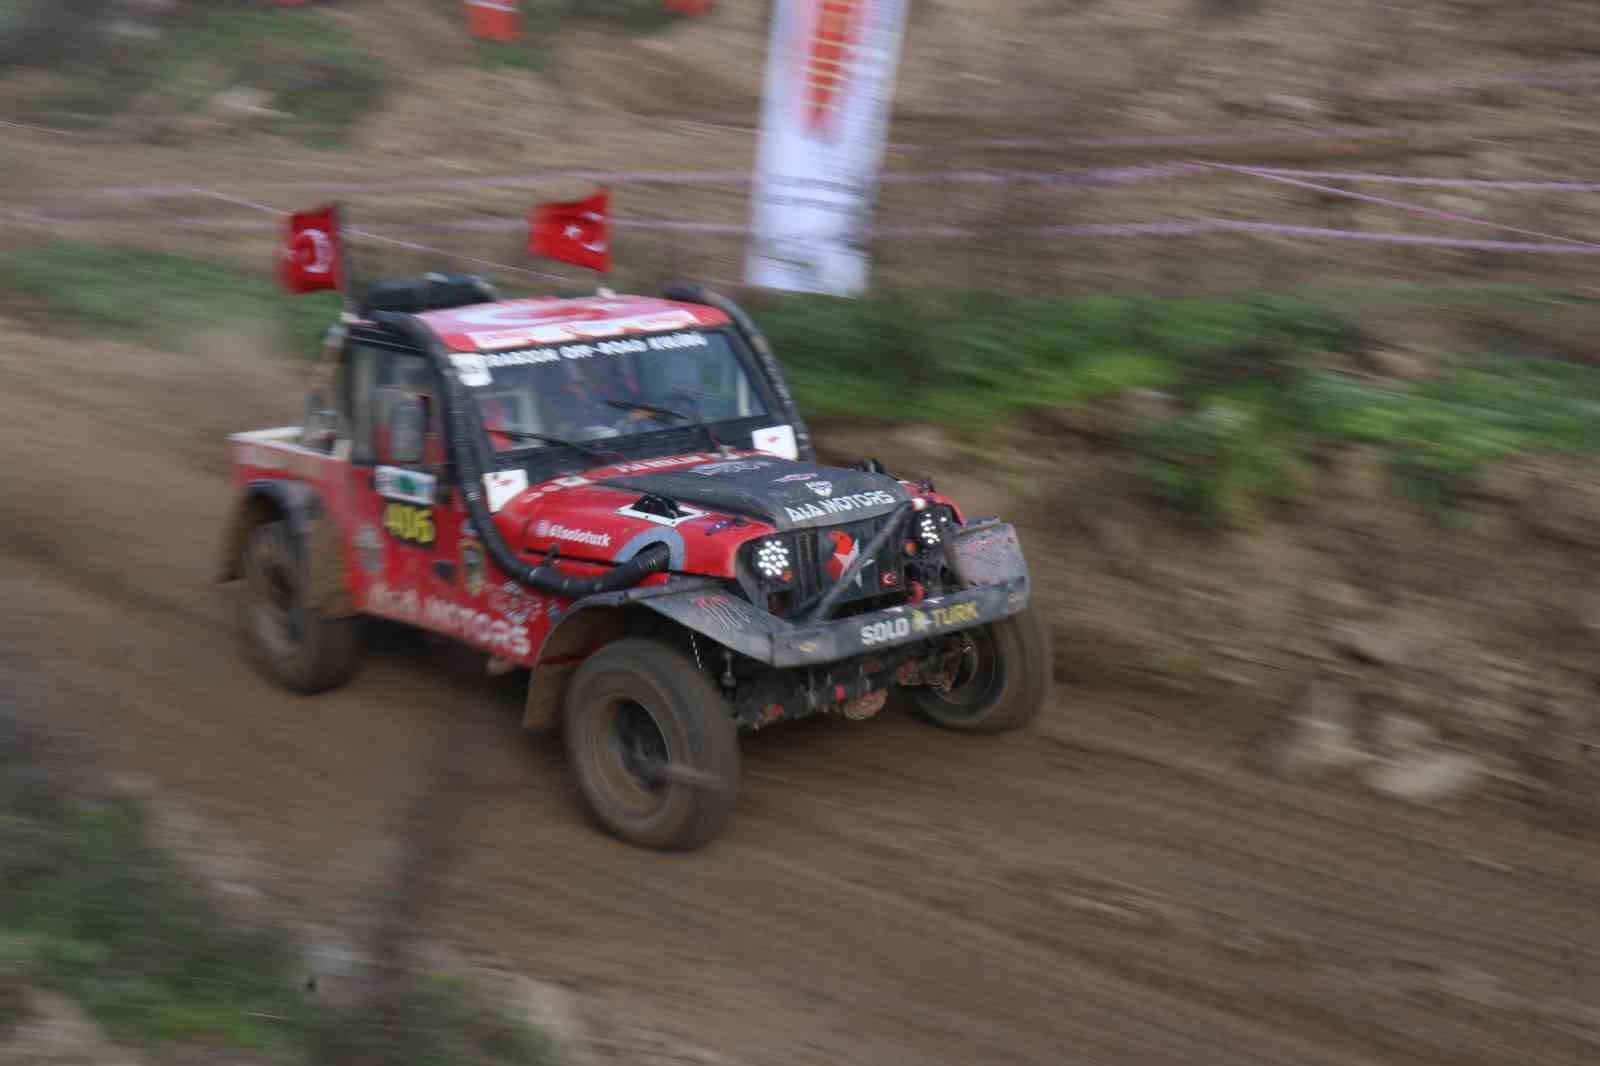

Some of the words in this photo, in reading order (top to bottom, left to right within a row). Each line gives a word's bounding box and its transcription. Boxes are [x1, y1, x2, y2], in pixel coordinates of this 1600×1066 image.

[817, 489, 896, 514] MOTORS
[384, 502, 436, 545] 406
[860, 617, 911, 646] SOLO
